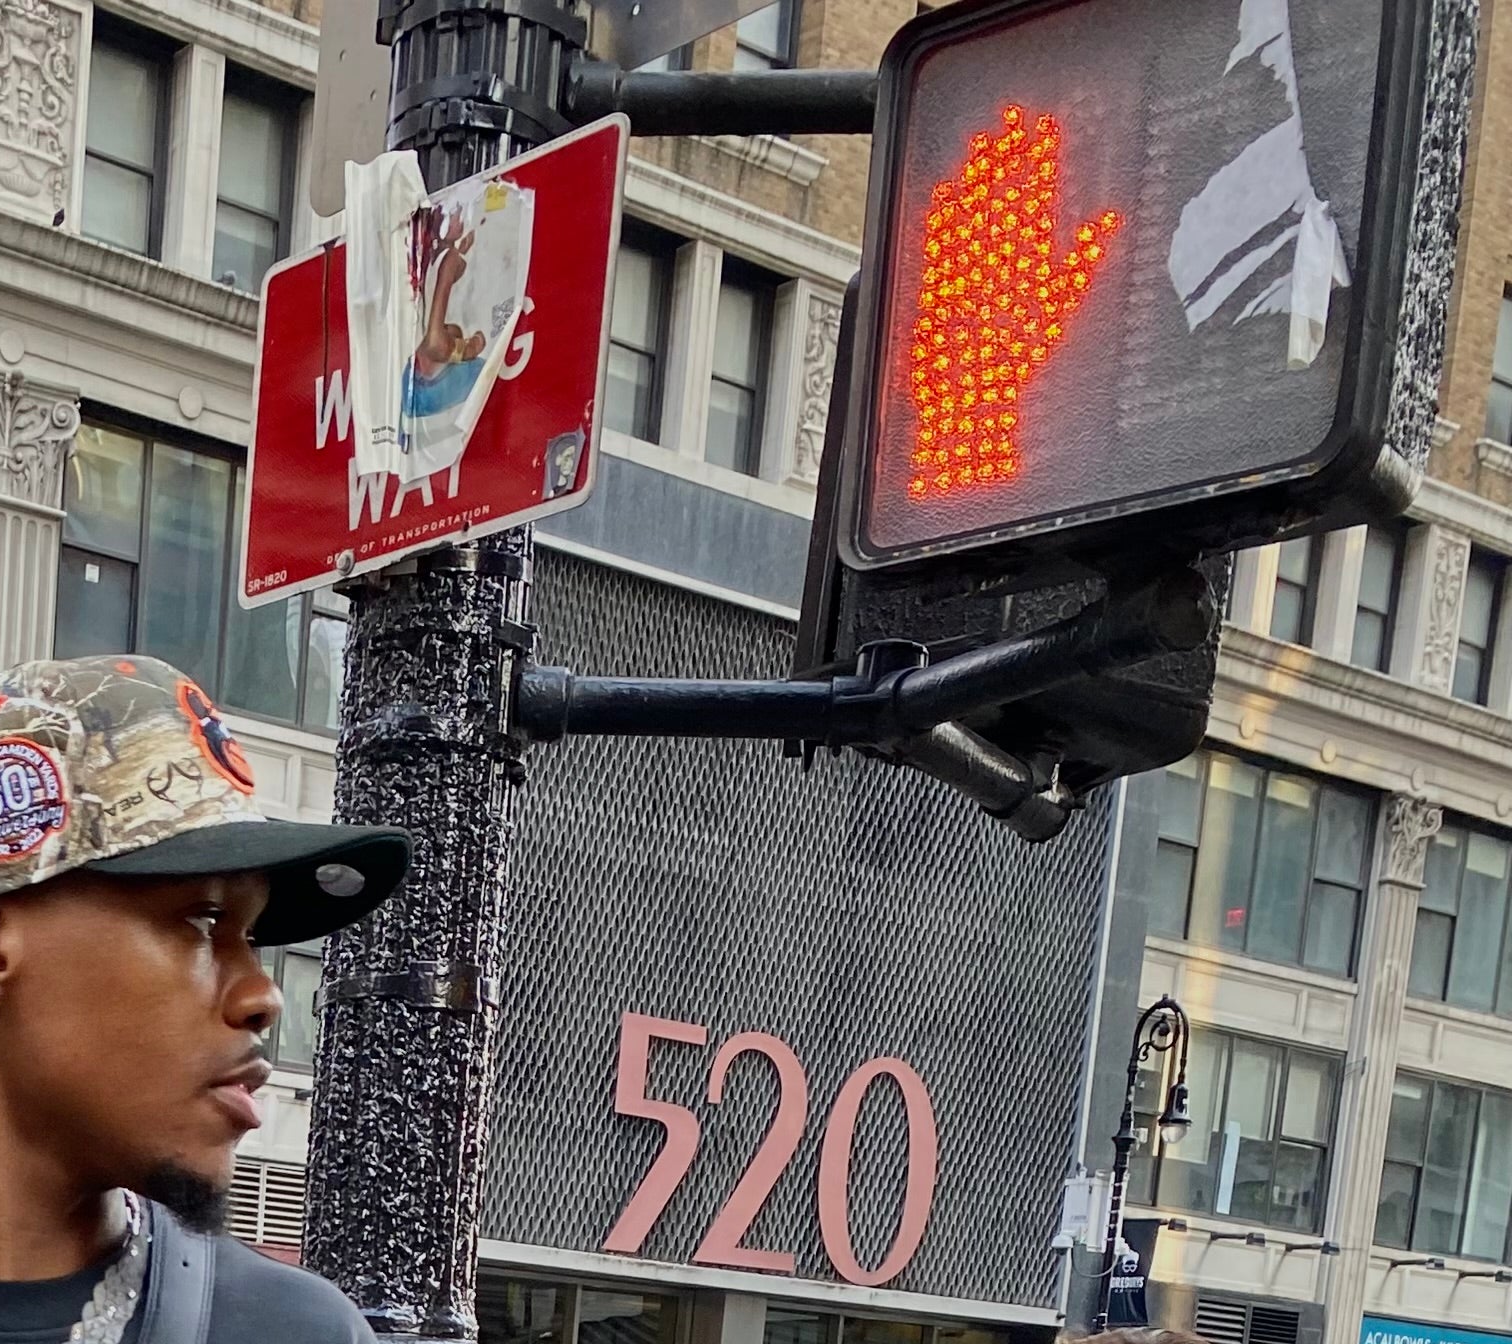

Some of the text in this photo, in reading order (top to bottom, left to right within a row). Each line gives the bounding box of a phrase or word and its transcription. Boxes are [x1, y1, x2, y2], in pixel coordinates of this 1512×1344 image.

[361, 542, 376, 553] OF
[382, 505, 490, 549] TRANSPORTATION
[248, 570, 287, 593] SR-1820
[603, 1012, 938, 1287] 520
